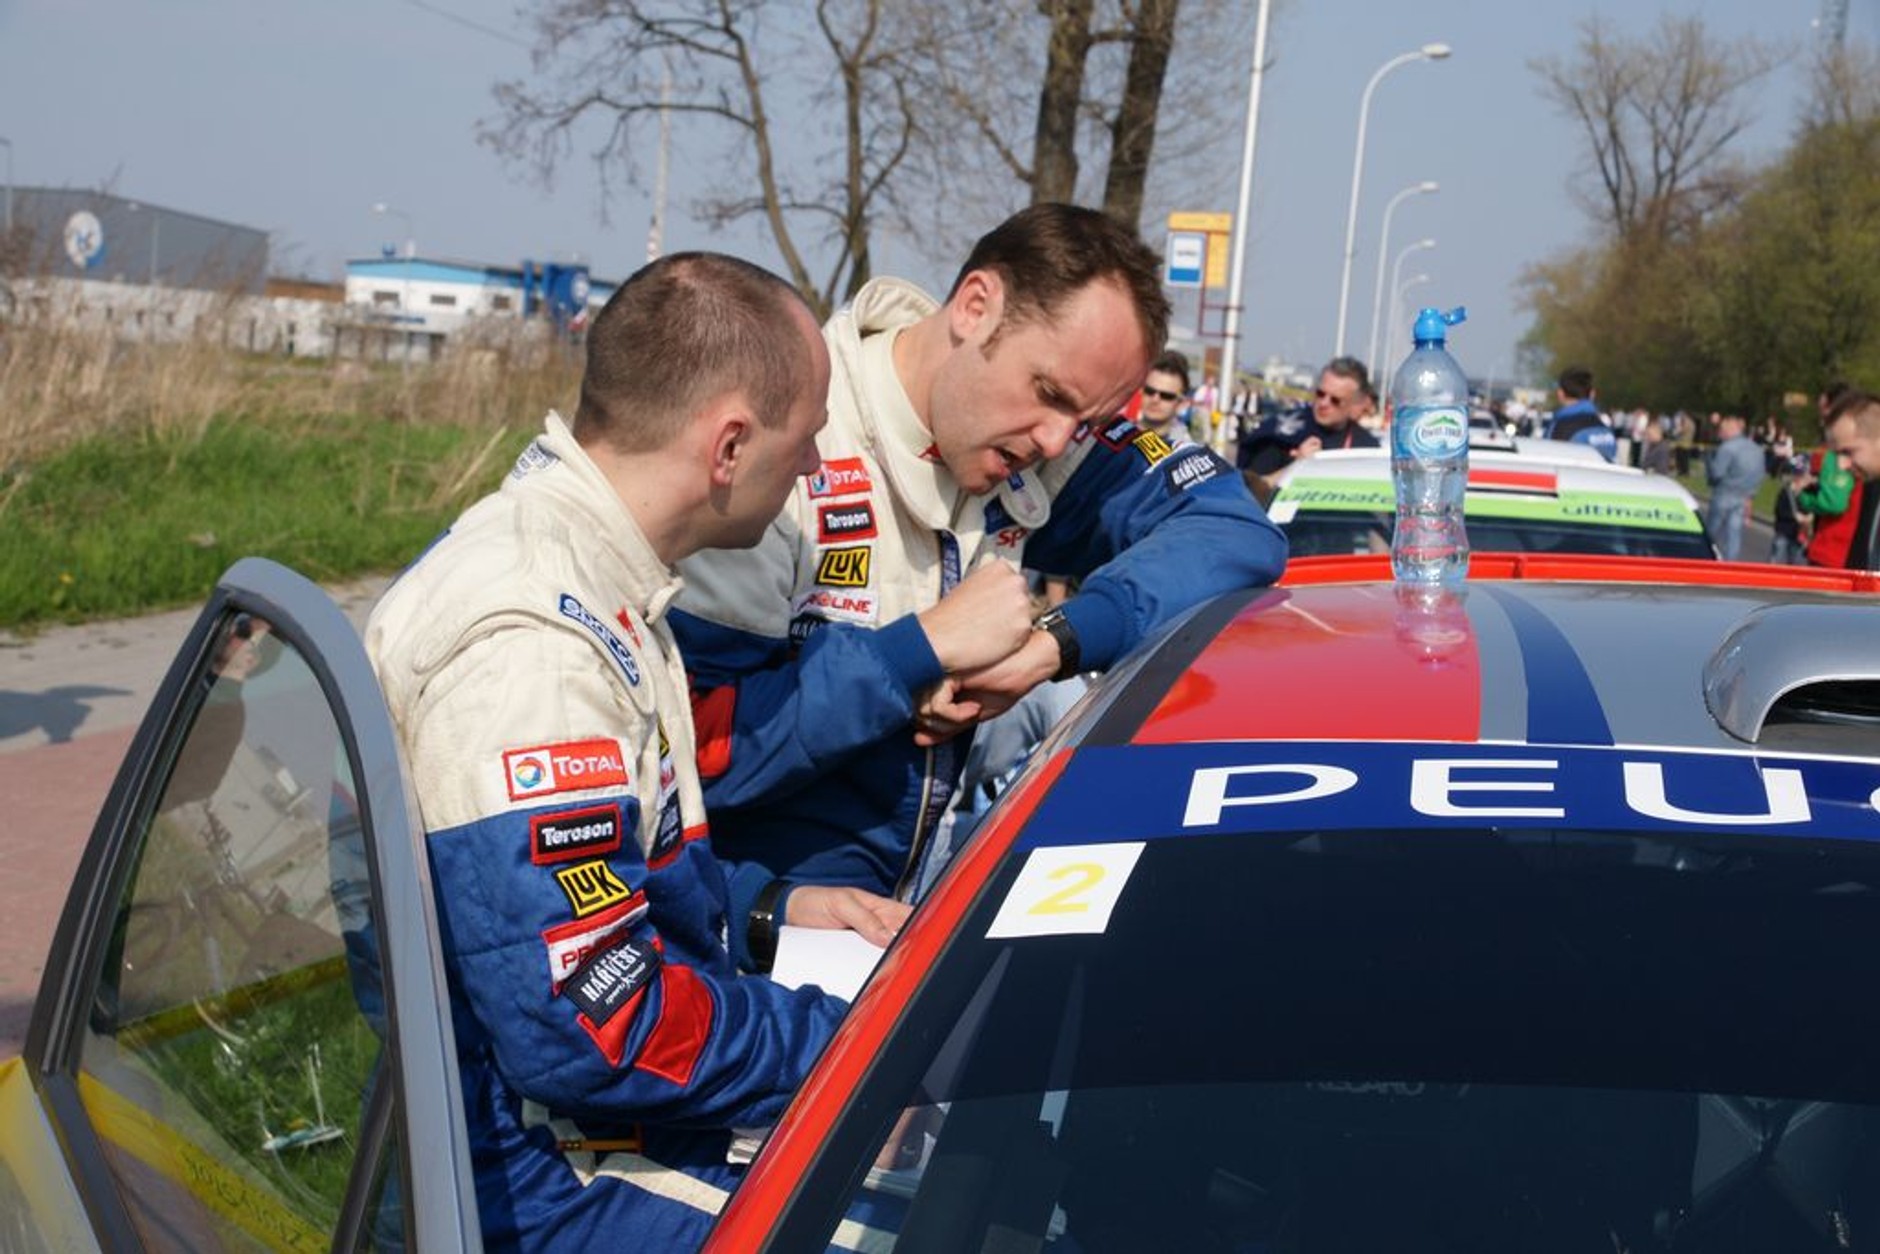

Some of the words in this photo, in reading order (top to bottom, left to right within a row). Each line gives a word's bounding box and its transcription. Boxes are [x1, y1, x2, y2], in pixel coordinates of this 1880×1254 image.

[827, 469, 872, 486] TOTAL
[553, 755, 624, 777] TOTAL
[1183, 759, 1880, 828] PEU
[541, 820, 613, 847] Teroson
[1027, 862, 1106, 915] 2
[580, 943, 643, 1002] HARVEST
